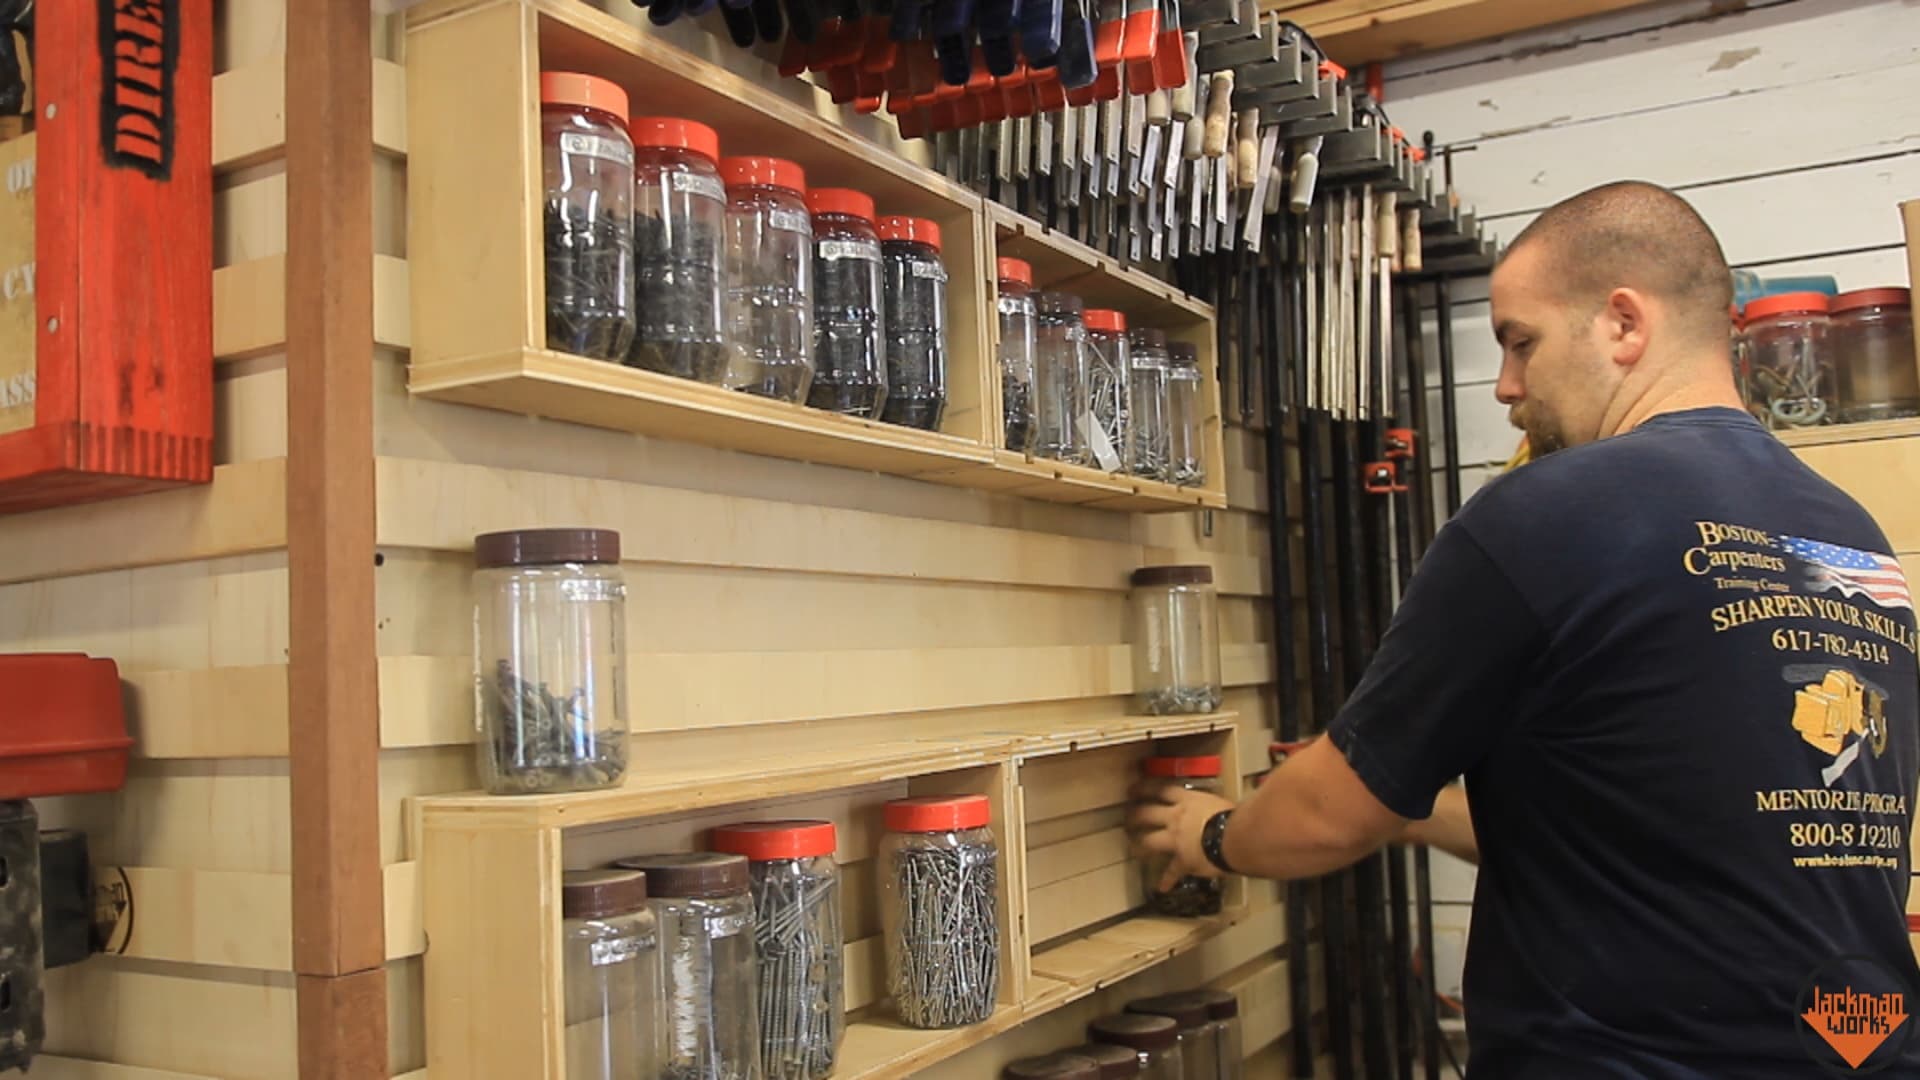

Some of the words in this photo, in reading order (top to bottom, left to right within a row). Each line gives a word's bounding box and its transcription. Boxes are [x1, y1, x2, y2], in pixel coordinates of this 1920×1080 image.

[1695, 520, 1769, 546] BOSTON
[1683, 546, 1786, 575] Carpenters
[1711, 594, 1813, 632] SHARPEN
[1813, 597, 1863, 628] YOUR
[1864, 610, 1916, 654] SKILLS
[1771, 628, 1890, 665] 617-782-4314
